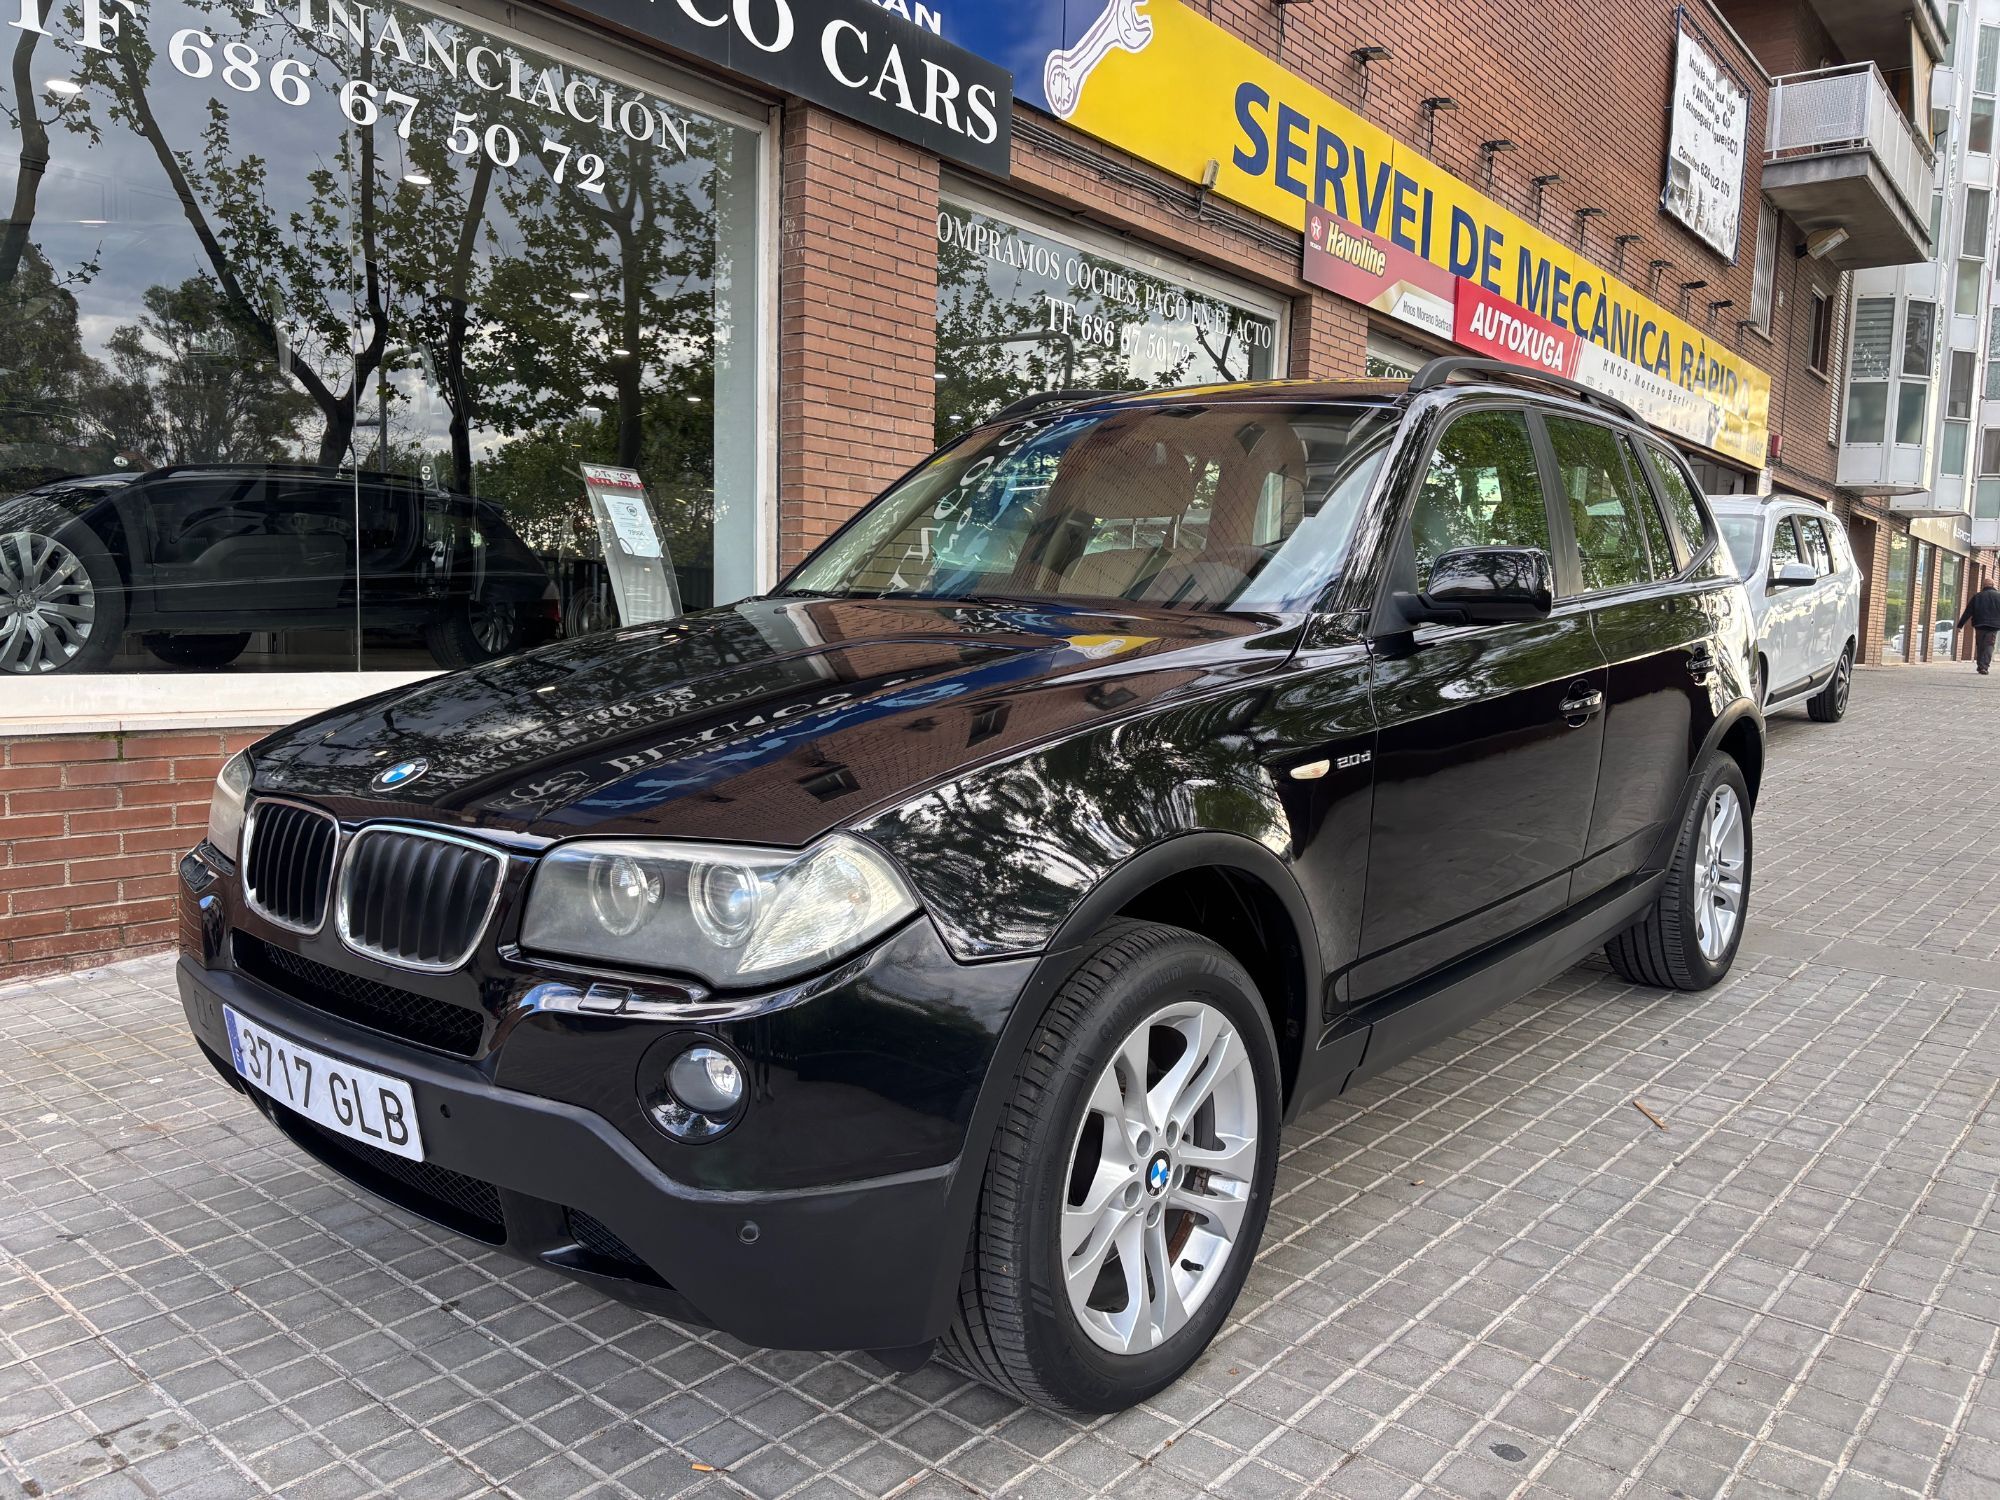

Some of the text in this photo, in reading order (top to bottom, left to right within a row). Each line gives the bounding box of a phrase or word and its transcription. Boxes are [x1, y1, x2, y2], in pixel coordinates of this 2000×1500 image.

[168, 28, 311, 106] 686
[340, 80, 420, 139] 67
[447, 110, 520, 167] 50
[542, 137, 606, 194] 72
[821, 19, 999, 145] CARS
[1233, 82, 1434, 260] SERVEI
[1449, 204, 1504, 295] DE
[1516, 246, 1672, 381] MECÀNICA
[1324, 219, 1388, 279] Havoline
[1044, 296, 1077, 337] TF
[1081, 314, 1115, 348] 686
[1120, 325, 1141, 356] 67
[1146, 332, 1167, 361] 50
[1065, 257, 1140, 312] COCHES,
[1145, 284, 1188, 322] PAGO
[1191, 300, 1211, 333] EN
[1215, 310, 1233, 338] EL
[1236, 316, 1272, 349] ACTO
[1416, 305, 1435, 326] Moreno
[1469, 302, 1565, 372] AUTOXUGA
[1602, 358, 1631, 383] HNOS.
[1634, 374, 1666, 398] Moreno
[243, 1028, 409, 1146] 3717 GLB
